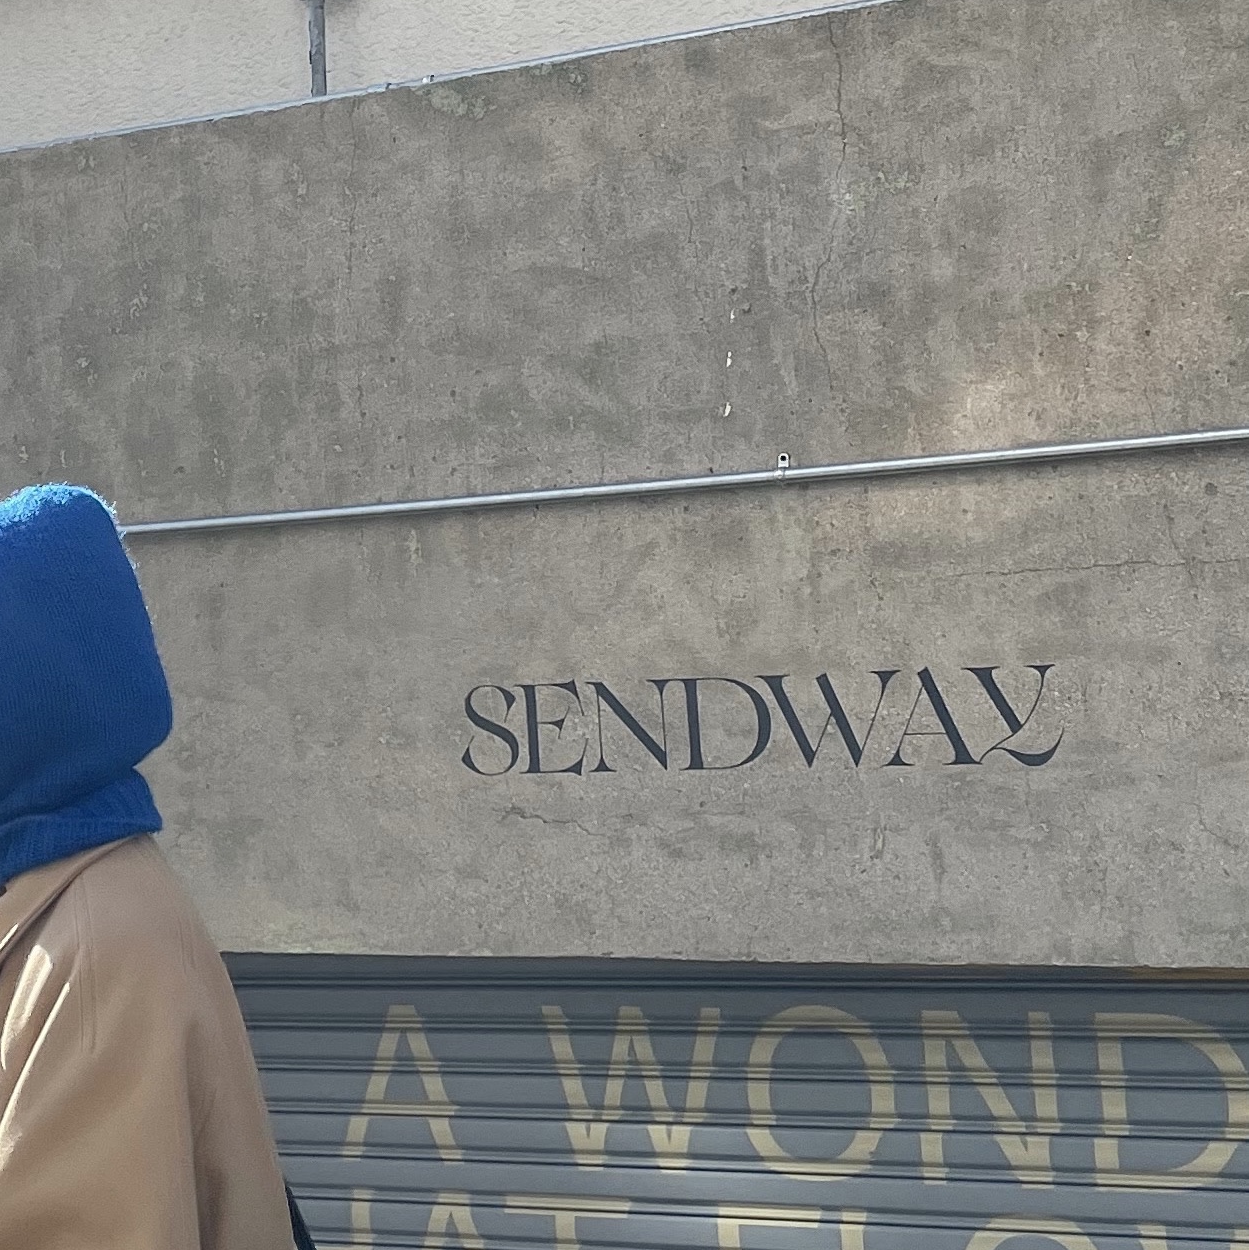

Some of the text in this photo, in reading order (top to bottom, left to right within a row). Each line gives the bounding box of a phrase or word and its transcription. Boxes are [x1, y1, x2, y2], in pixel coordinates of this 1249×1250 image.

[461, 664, 1064, 776] SENDWAY
[343, 1004, 1249, 1193] A WOND
